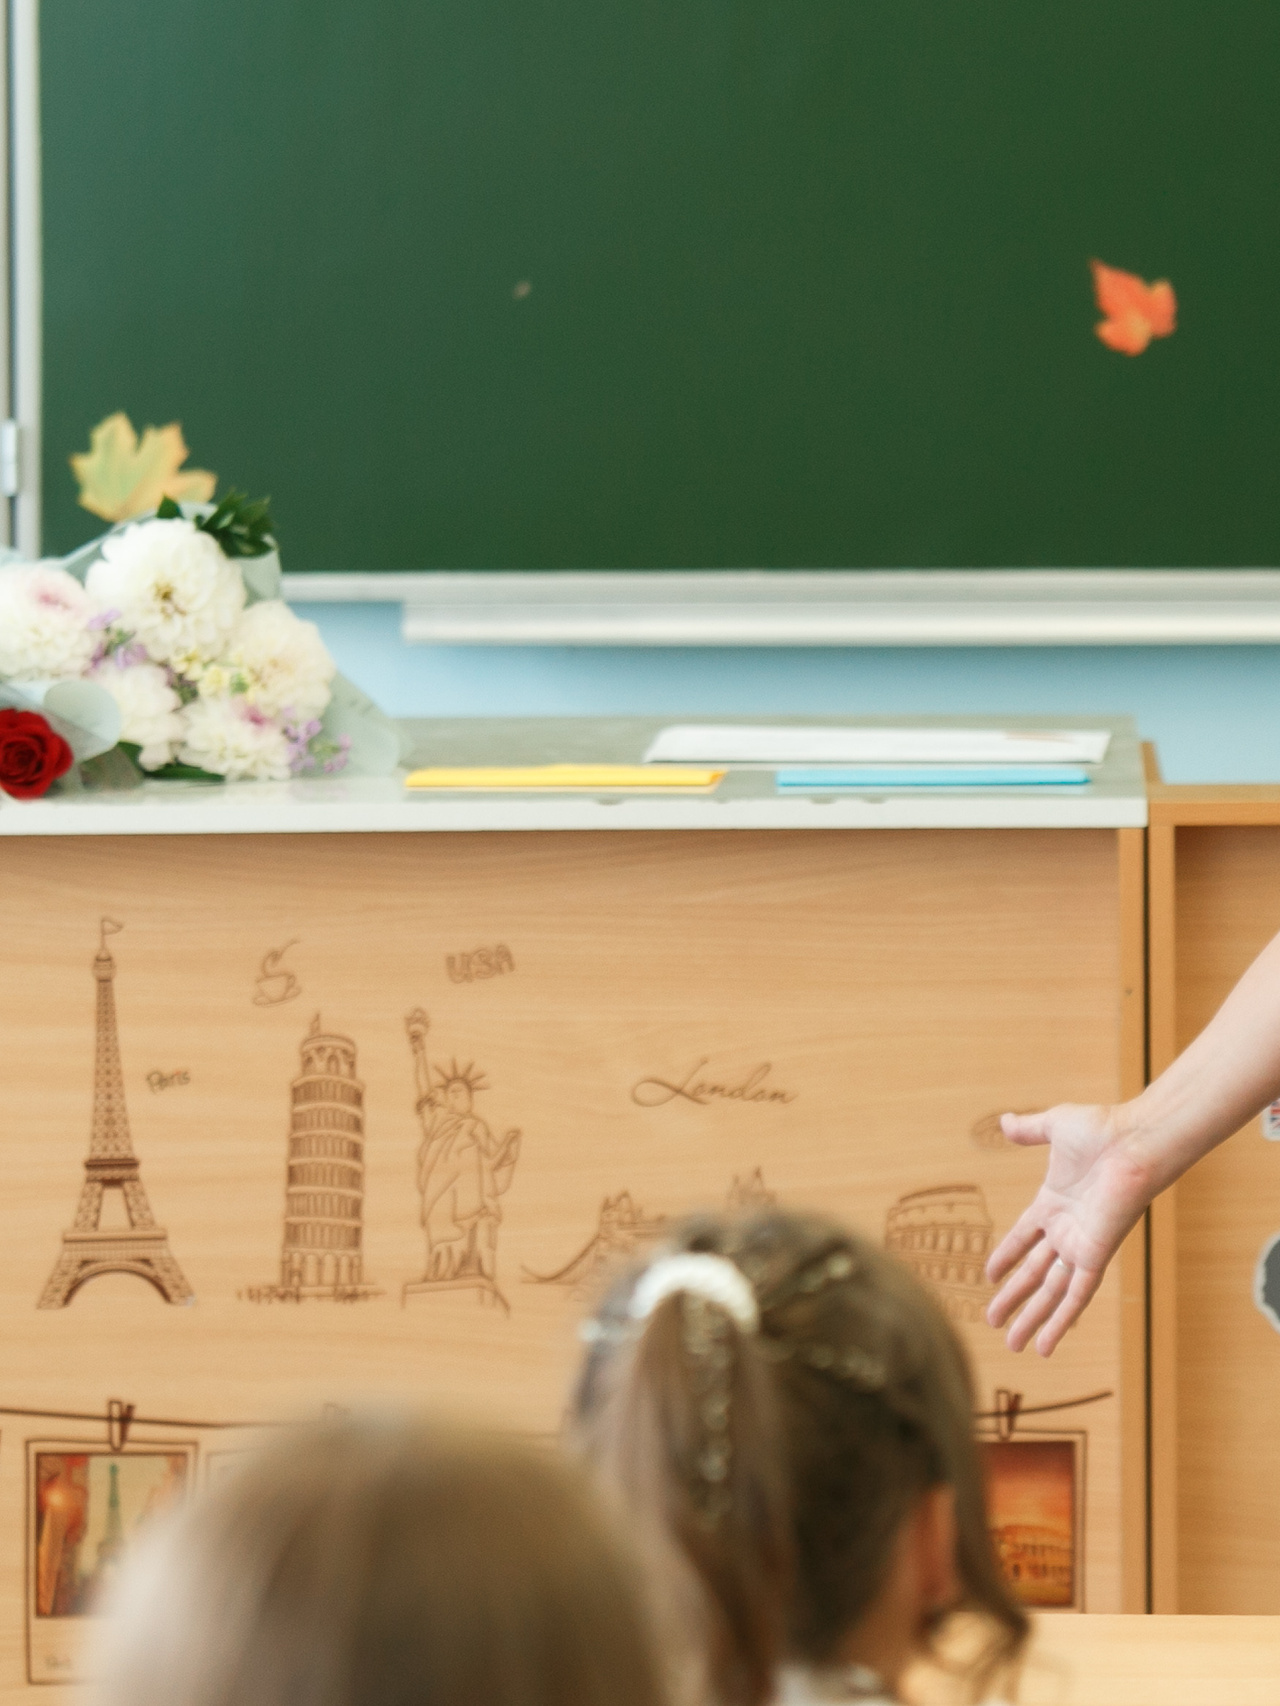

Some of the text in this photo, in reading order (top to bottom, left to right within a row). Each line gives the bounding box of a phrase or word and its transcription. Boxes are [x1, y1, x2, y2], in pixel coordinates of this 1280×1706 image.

[445, 944, 515, 984] USA
[146, 1070, 191, 1095] Paris
[631, 1057, 799, 1107] London
